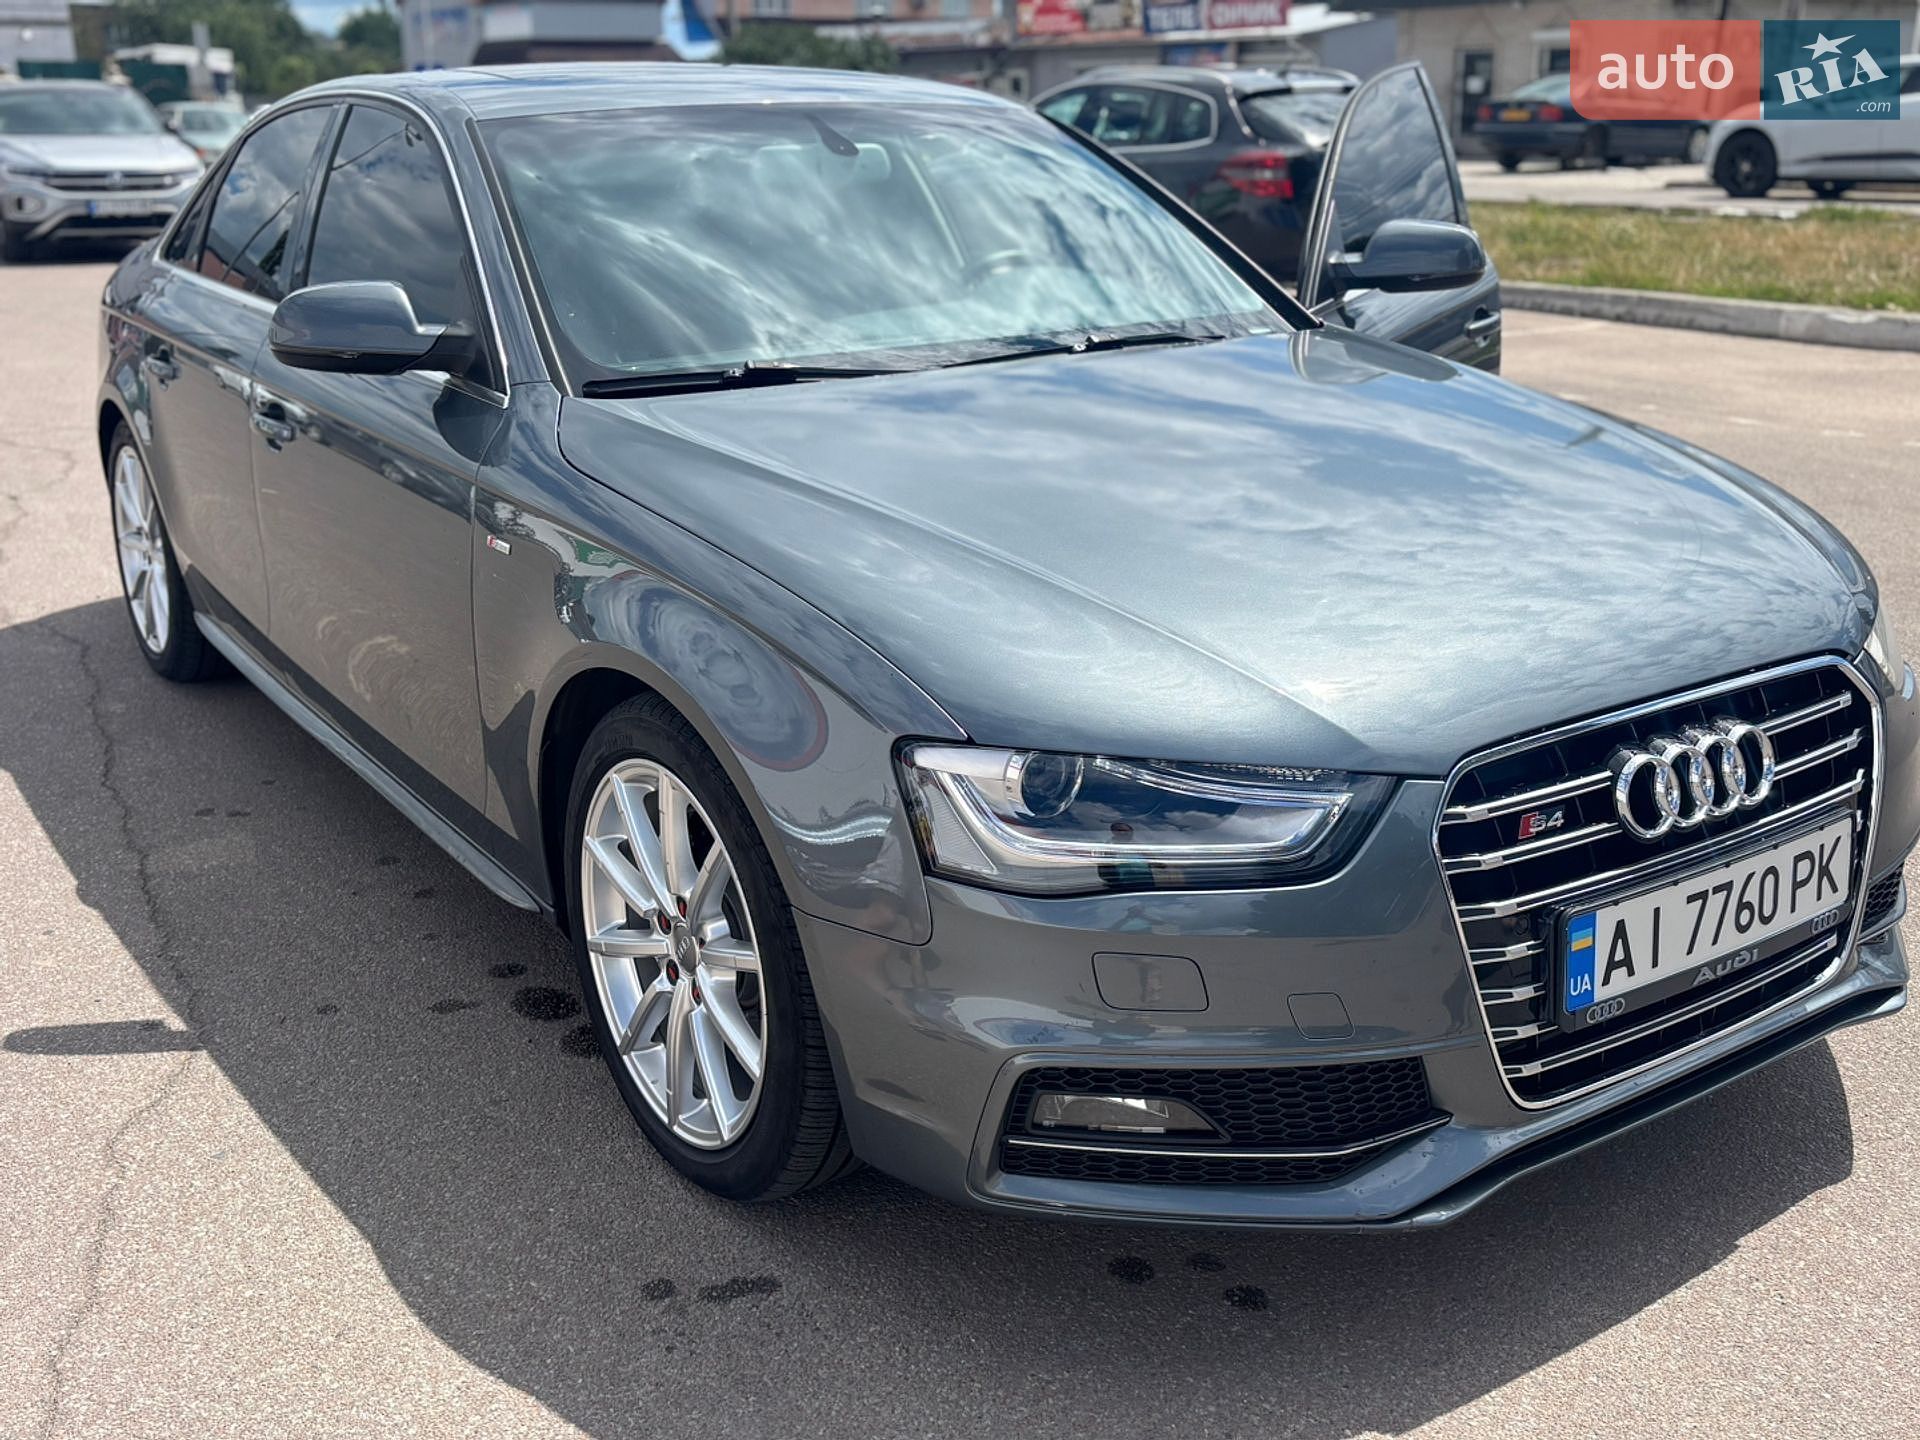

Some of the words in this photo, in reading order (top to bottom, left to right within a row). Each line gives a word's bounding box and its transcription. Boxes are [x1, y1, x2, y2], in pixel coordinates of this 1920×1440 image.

[1521, 811, 1564, 836] S4
[1602, 907, 1661, 987] AI
[1686, 865, 1780, 956] 7760
[1790, 835, 1841, 914] PK
[1570, 973, 1592, 996] UA
